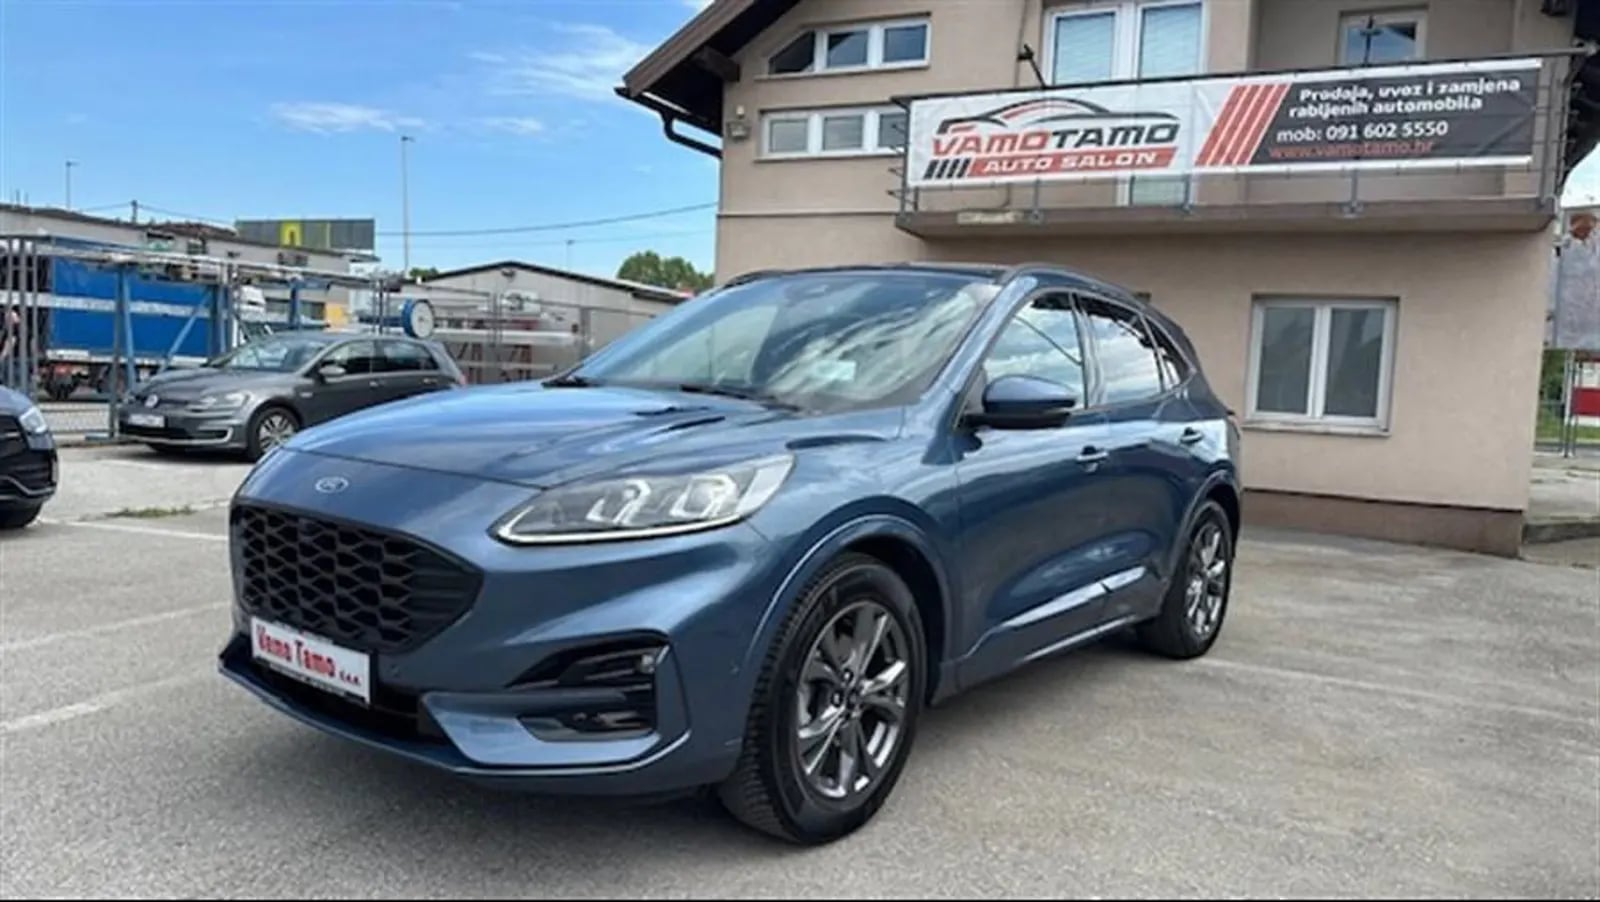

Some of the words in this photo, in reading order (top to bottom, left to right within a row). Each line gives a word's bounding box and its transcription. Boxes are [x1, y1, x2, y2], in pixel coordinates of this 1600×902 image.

[1299, 85, 1374, 103] Prodaja,
[1378, 84, 1423, 98] uvoz
[1426, 80, 1433, 95] i
[1437, 77, 1521, 95] zamjena
[1288, 101, 1369, 119] rabljenih
[1372, 95, 1483, 114] automobila
[1276, 126, 1321, 142] mob:
[1325, 124, 1359, 140] 091
[1363, 122, 1397, 139] 602
[1401, 120, 1449, 137] 5550
[983, 158, 1054, 173] AUTO
[1060, 151, 1158, 169] SALON
